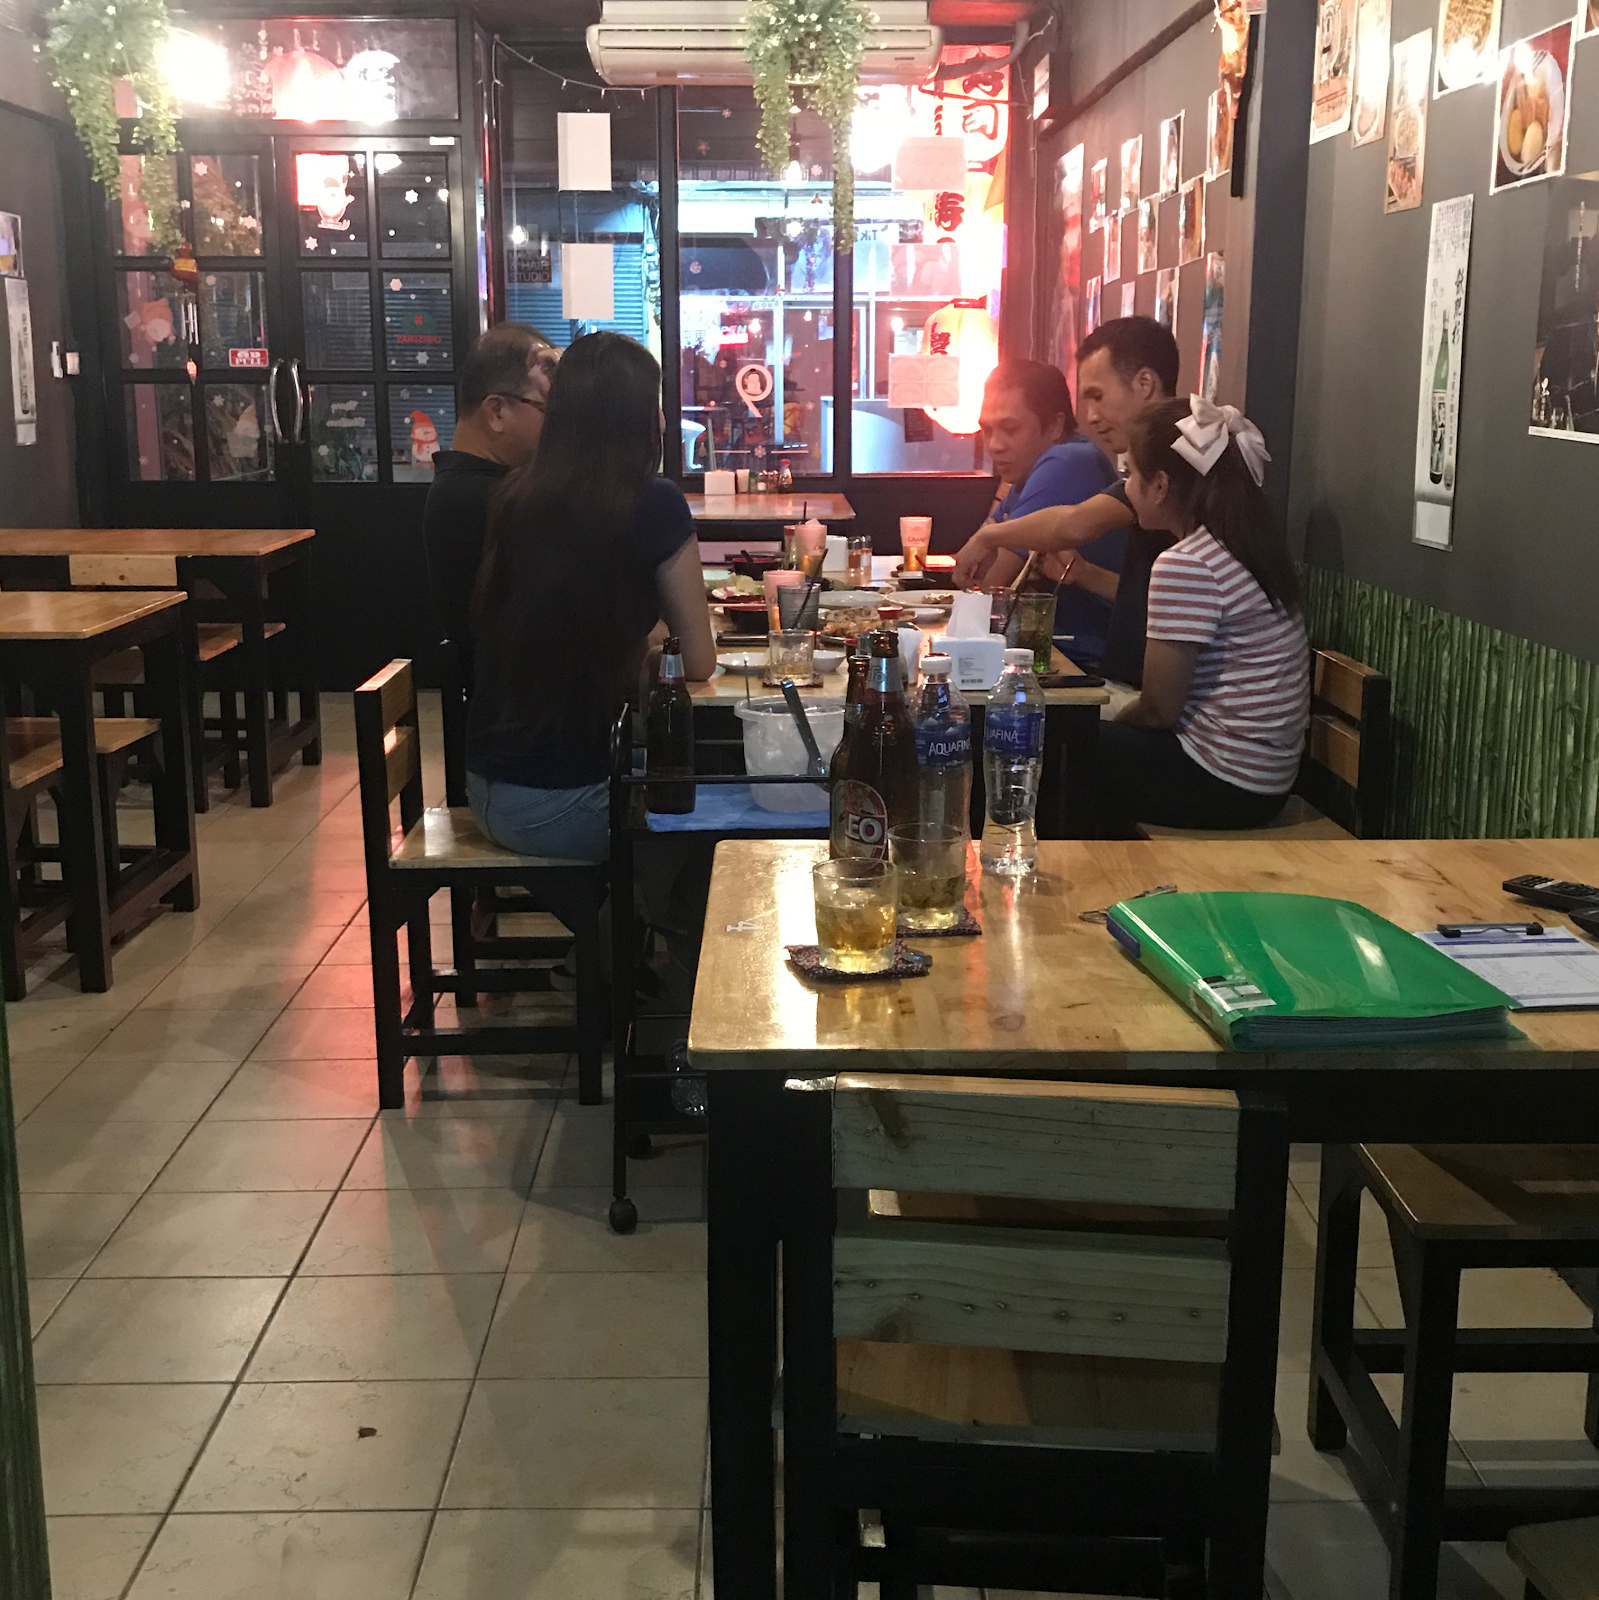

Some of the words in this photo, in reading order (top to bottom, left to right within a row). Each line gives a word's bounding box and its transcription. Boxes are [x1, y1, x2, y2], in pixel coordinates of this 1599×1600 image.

[509, 272, 550, 282] STUDIO
[986, 728, 1021, 744] UAFINA
[928, 737, 970, 757] AQUAFIN
[848, 812, 883, 844] EO
